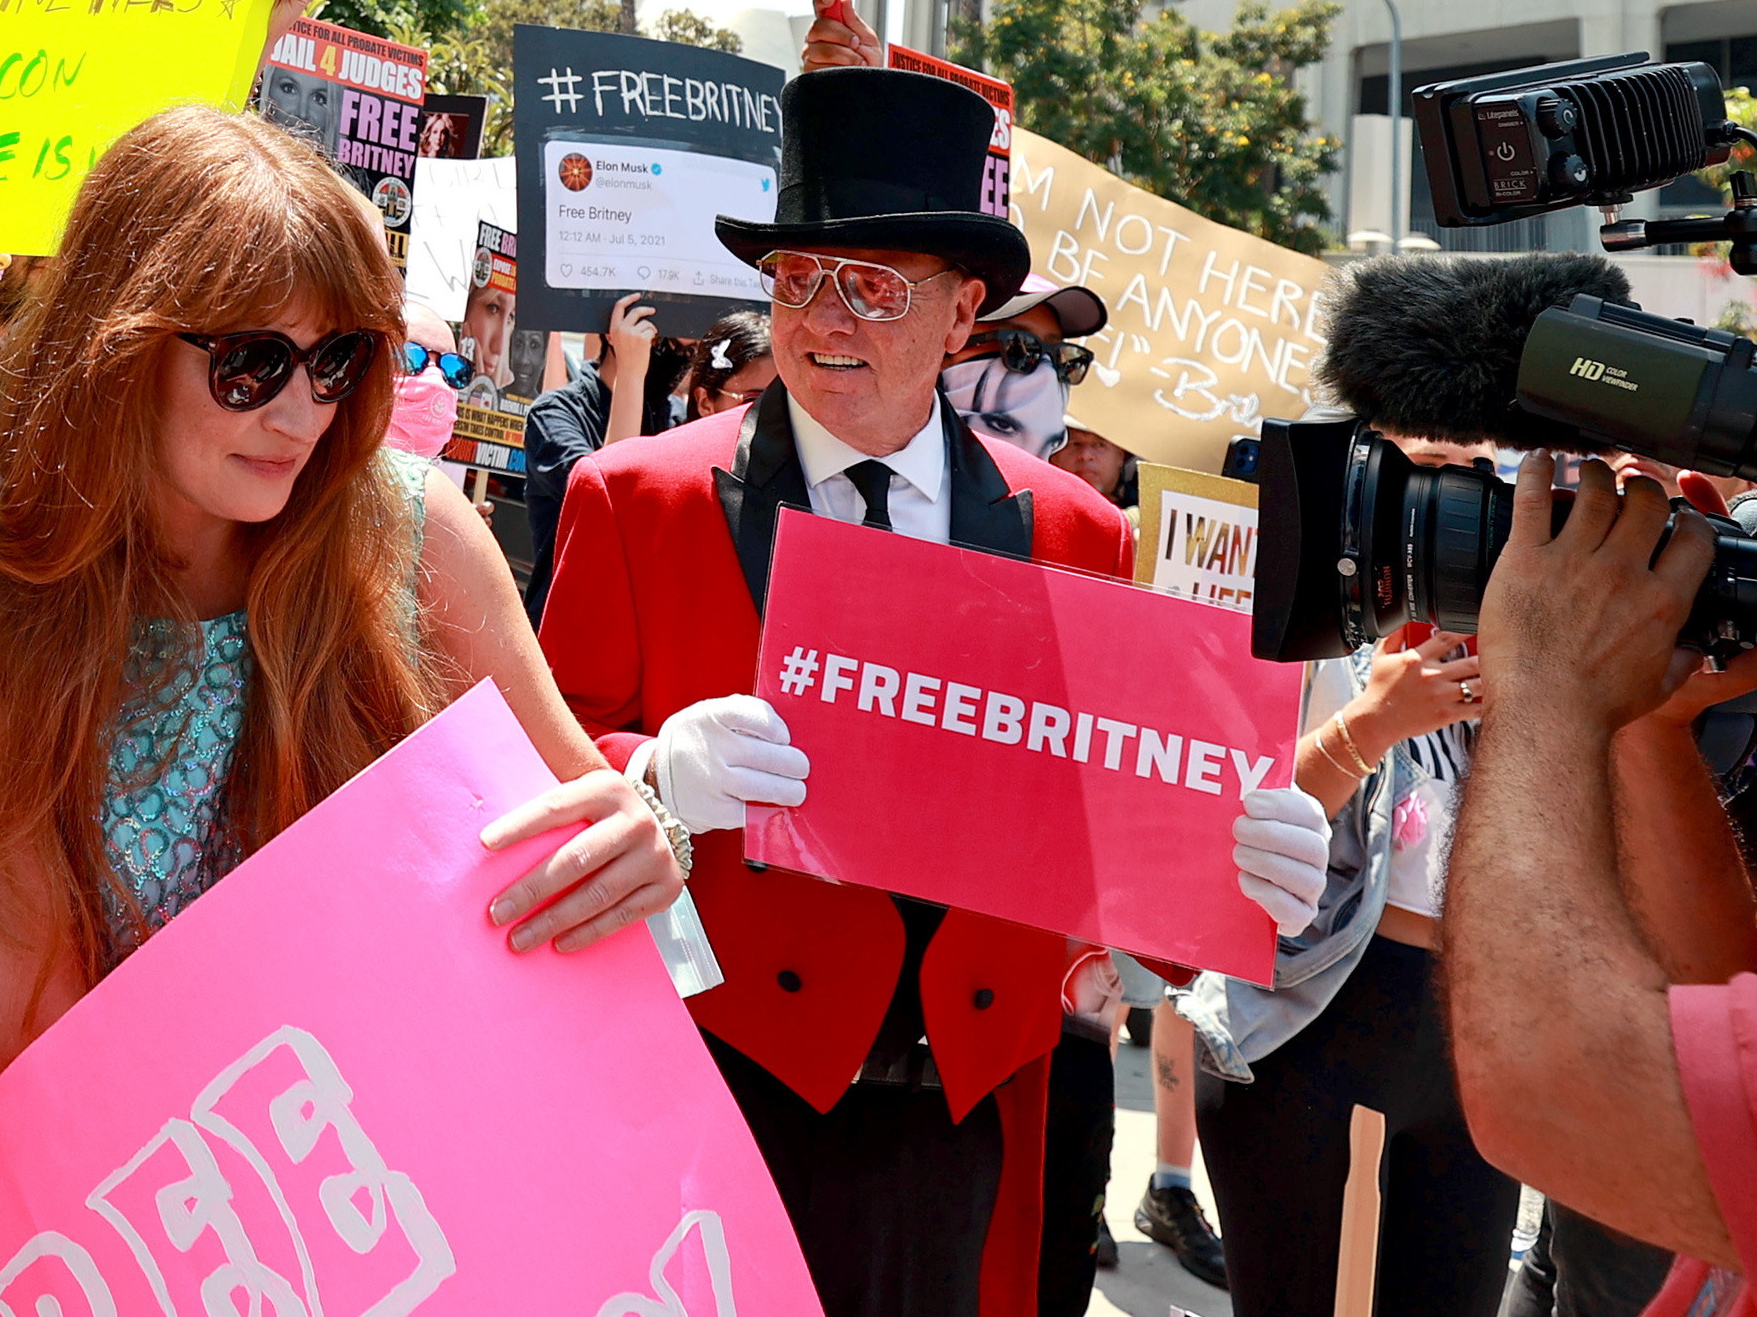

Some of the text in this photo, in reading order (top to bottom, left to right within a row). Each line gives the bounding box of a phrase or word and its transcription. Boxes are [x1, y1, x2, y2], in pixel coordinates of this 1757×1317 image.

[290, 22, 424, 67] TICE FOR ALL PROBATE VICTIMS
[270, 34, 423, 100] JAIL 4 JUDGES
[339, 89, 419, 152] FREE
[32, 135, 73, 181] IS
[338, 138, 415, 179] BRITNEY
[596, 160, 648, 173] Elon Musk
[596, 177, 652, 190] @elonmusk
[1494, 179, 1526, 189] BRICK
[558, 205, 632, 224] Free Britney
[479, 223, 502, 252] FREE
[559, 231, 665, 246] 12:12 AM Jul 5, 2021
[1075, 187, 1191, 276] NOT
[581, 266, 616, 278] 454.7K
[710, 275, 731, 285] Share
[1570, 357, 1627, 381] HD COLOR
[1602, 375, 1639, 391] VIEWFINDER
[1165, 509, 1258, 577] I WAN
[780, 646, 1275, 801] #FREEBRITNEY
